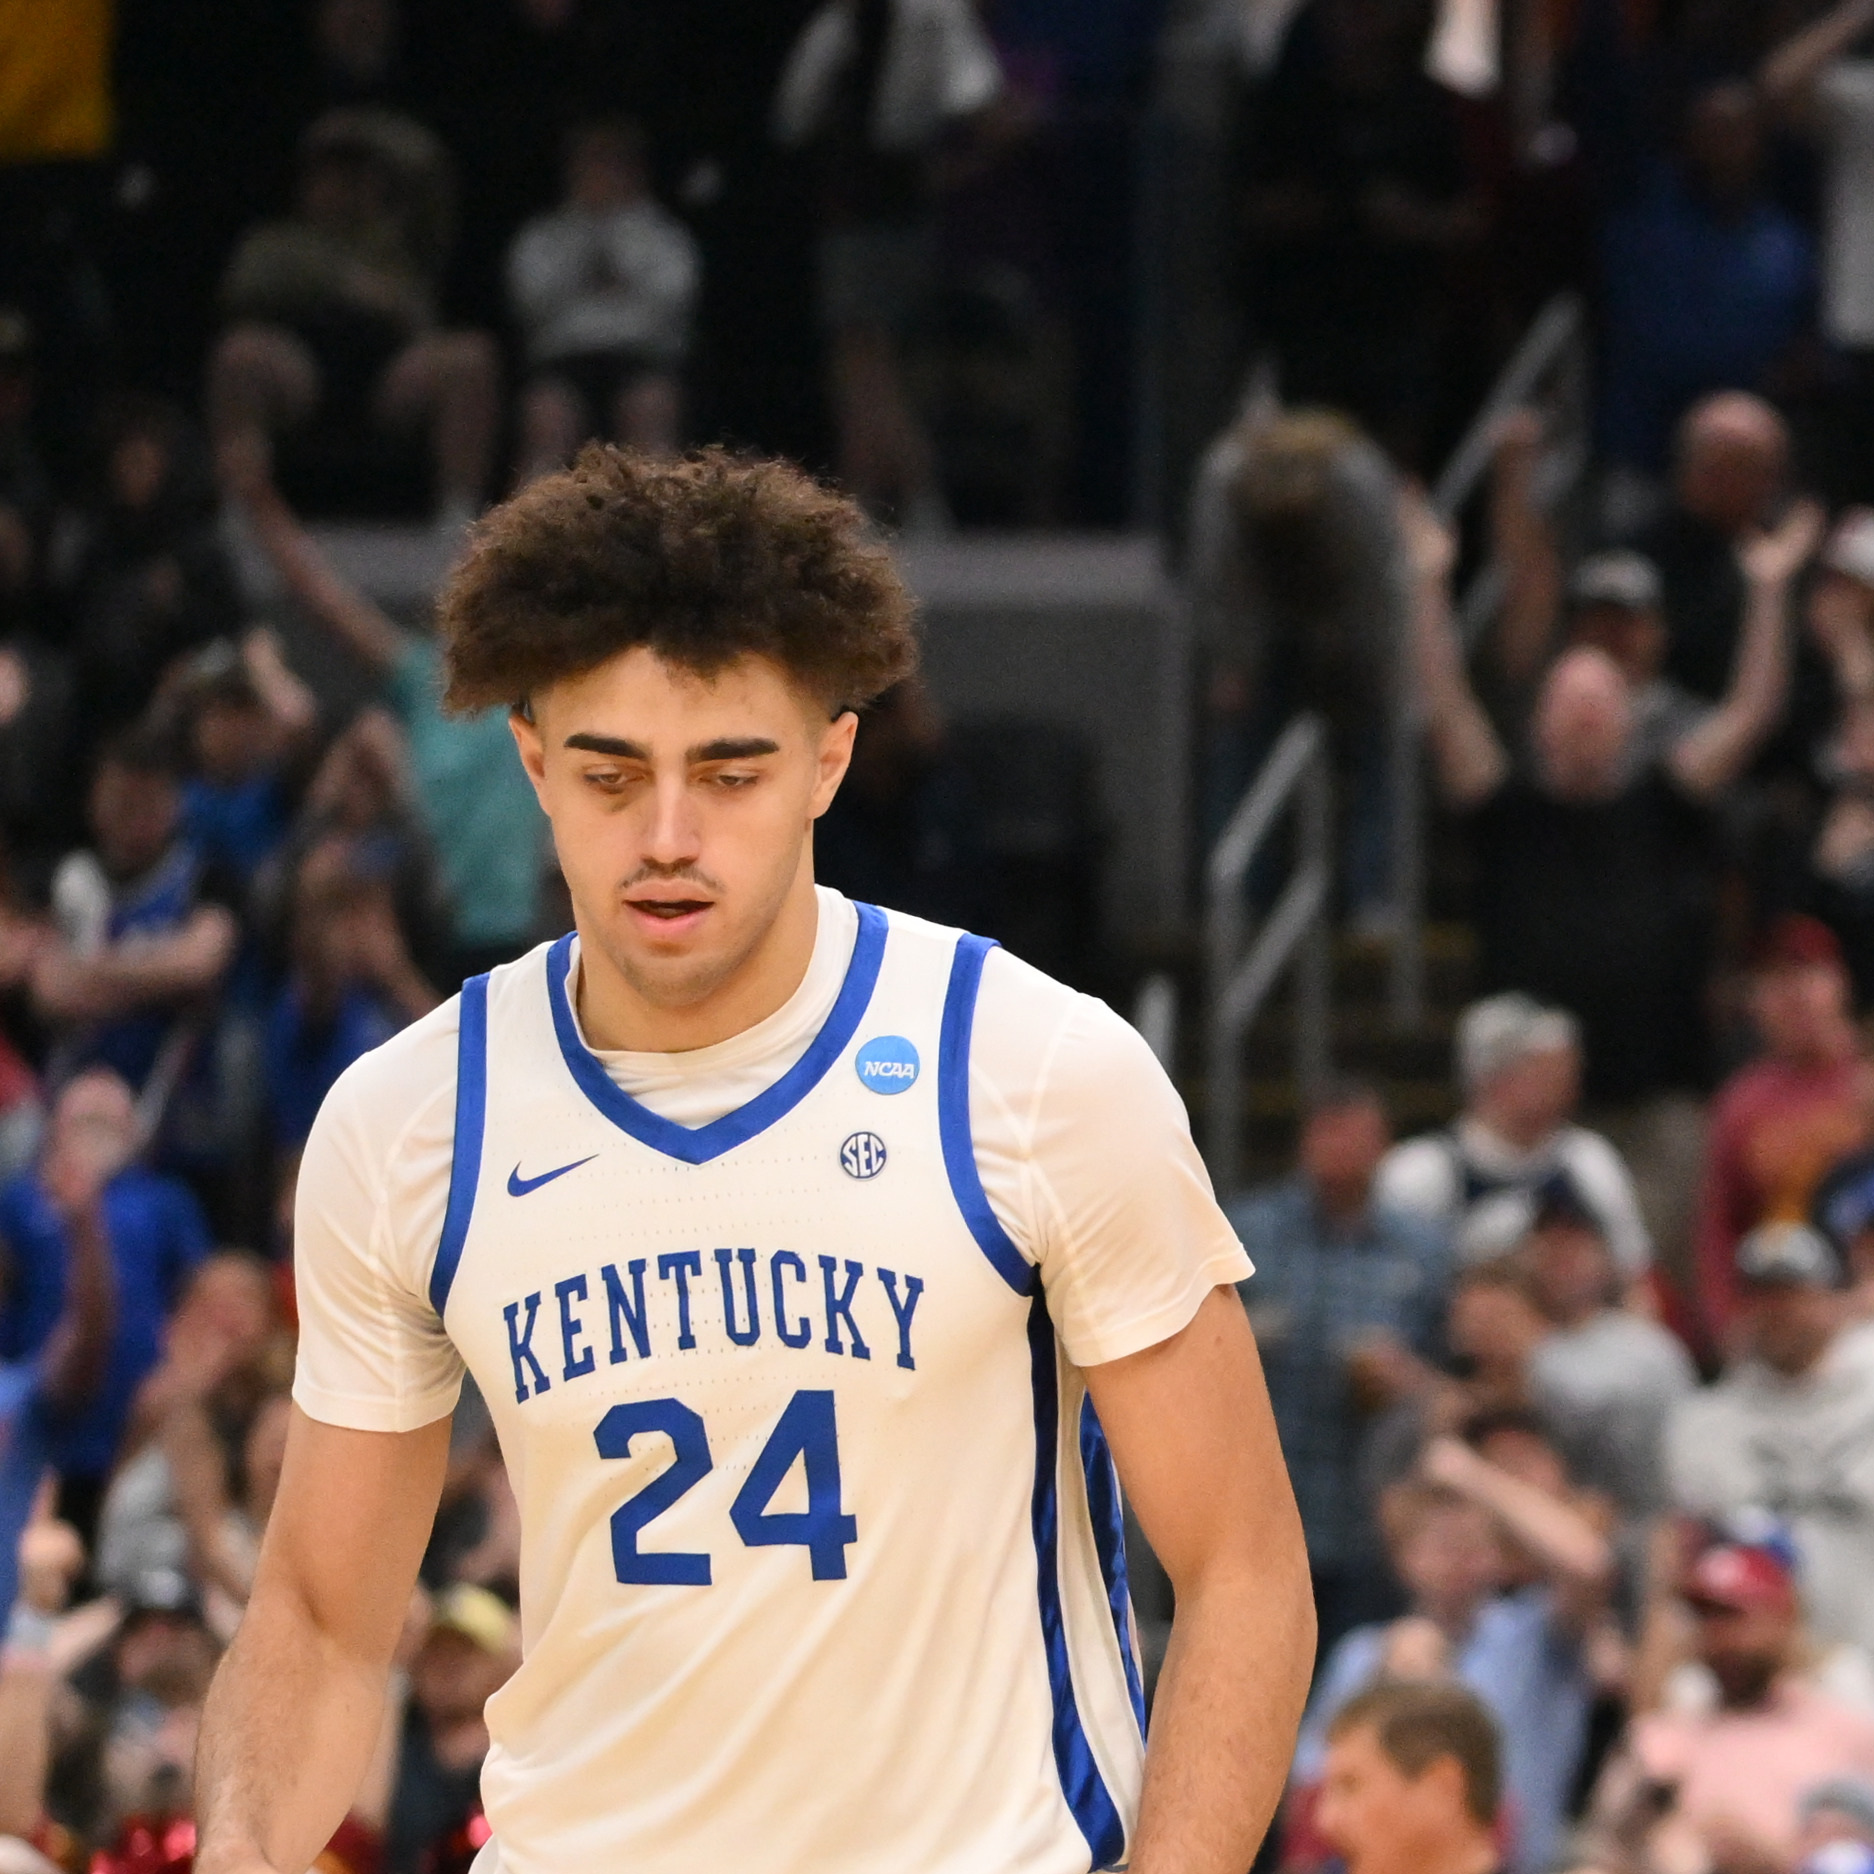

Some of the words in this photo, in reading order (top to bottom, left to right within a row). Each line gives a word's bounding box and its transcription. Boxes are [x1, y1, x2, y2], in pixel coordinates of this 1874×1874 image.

[864, 1061, 916, 1080] NCAA
[842, 1133, 885, 1178] SEC
[503, 1247, 924, 1405] KENTUCKY
[592, 1389, 858, 1586] 24
